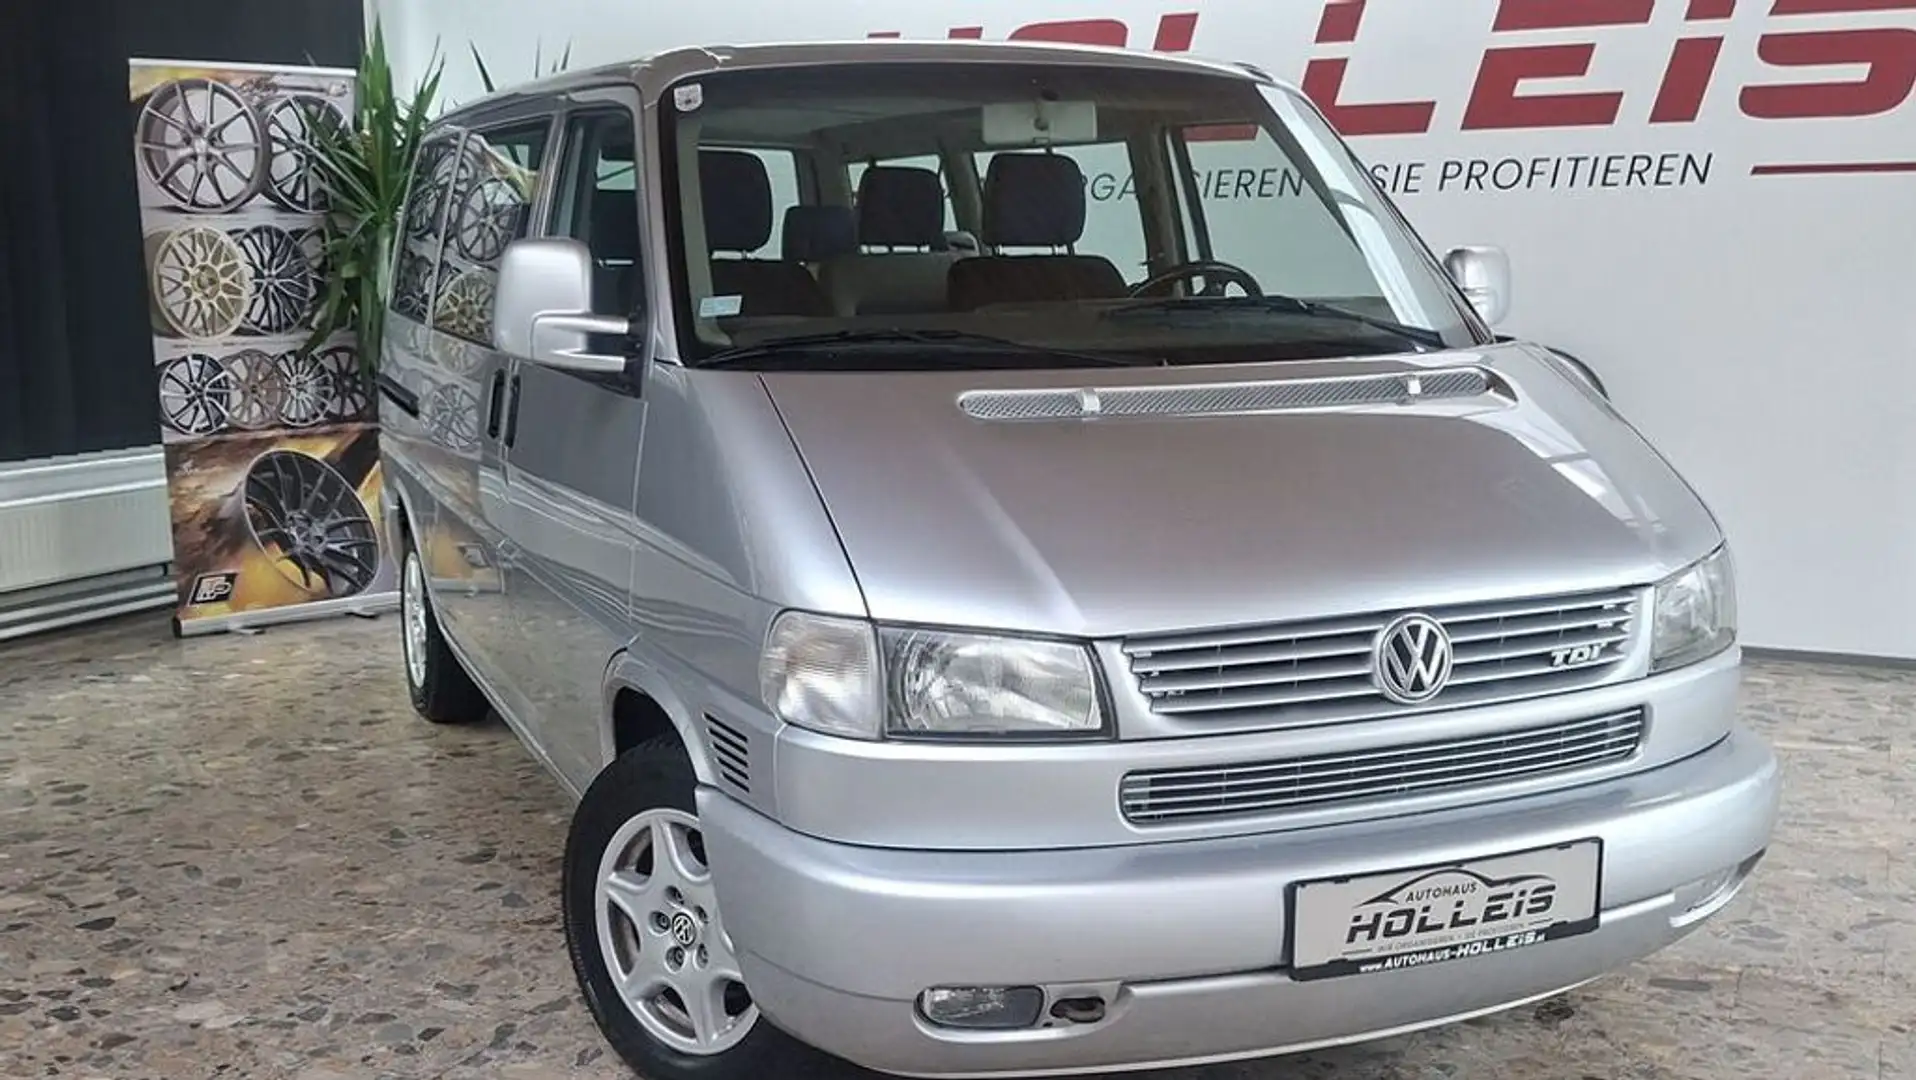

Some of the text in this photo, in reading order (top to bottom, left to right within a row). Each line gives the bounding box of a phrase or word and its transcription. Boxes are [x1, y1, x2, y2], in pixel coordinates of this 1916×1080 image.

[1438, 152, 1714, 192] PROFITIEREN
[1550, 641, 1608, 667] TDI
[1405, 882, 1477, 902] AUTOHAUS
